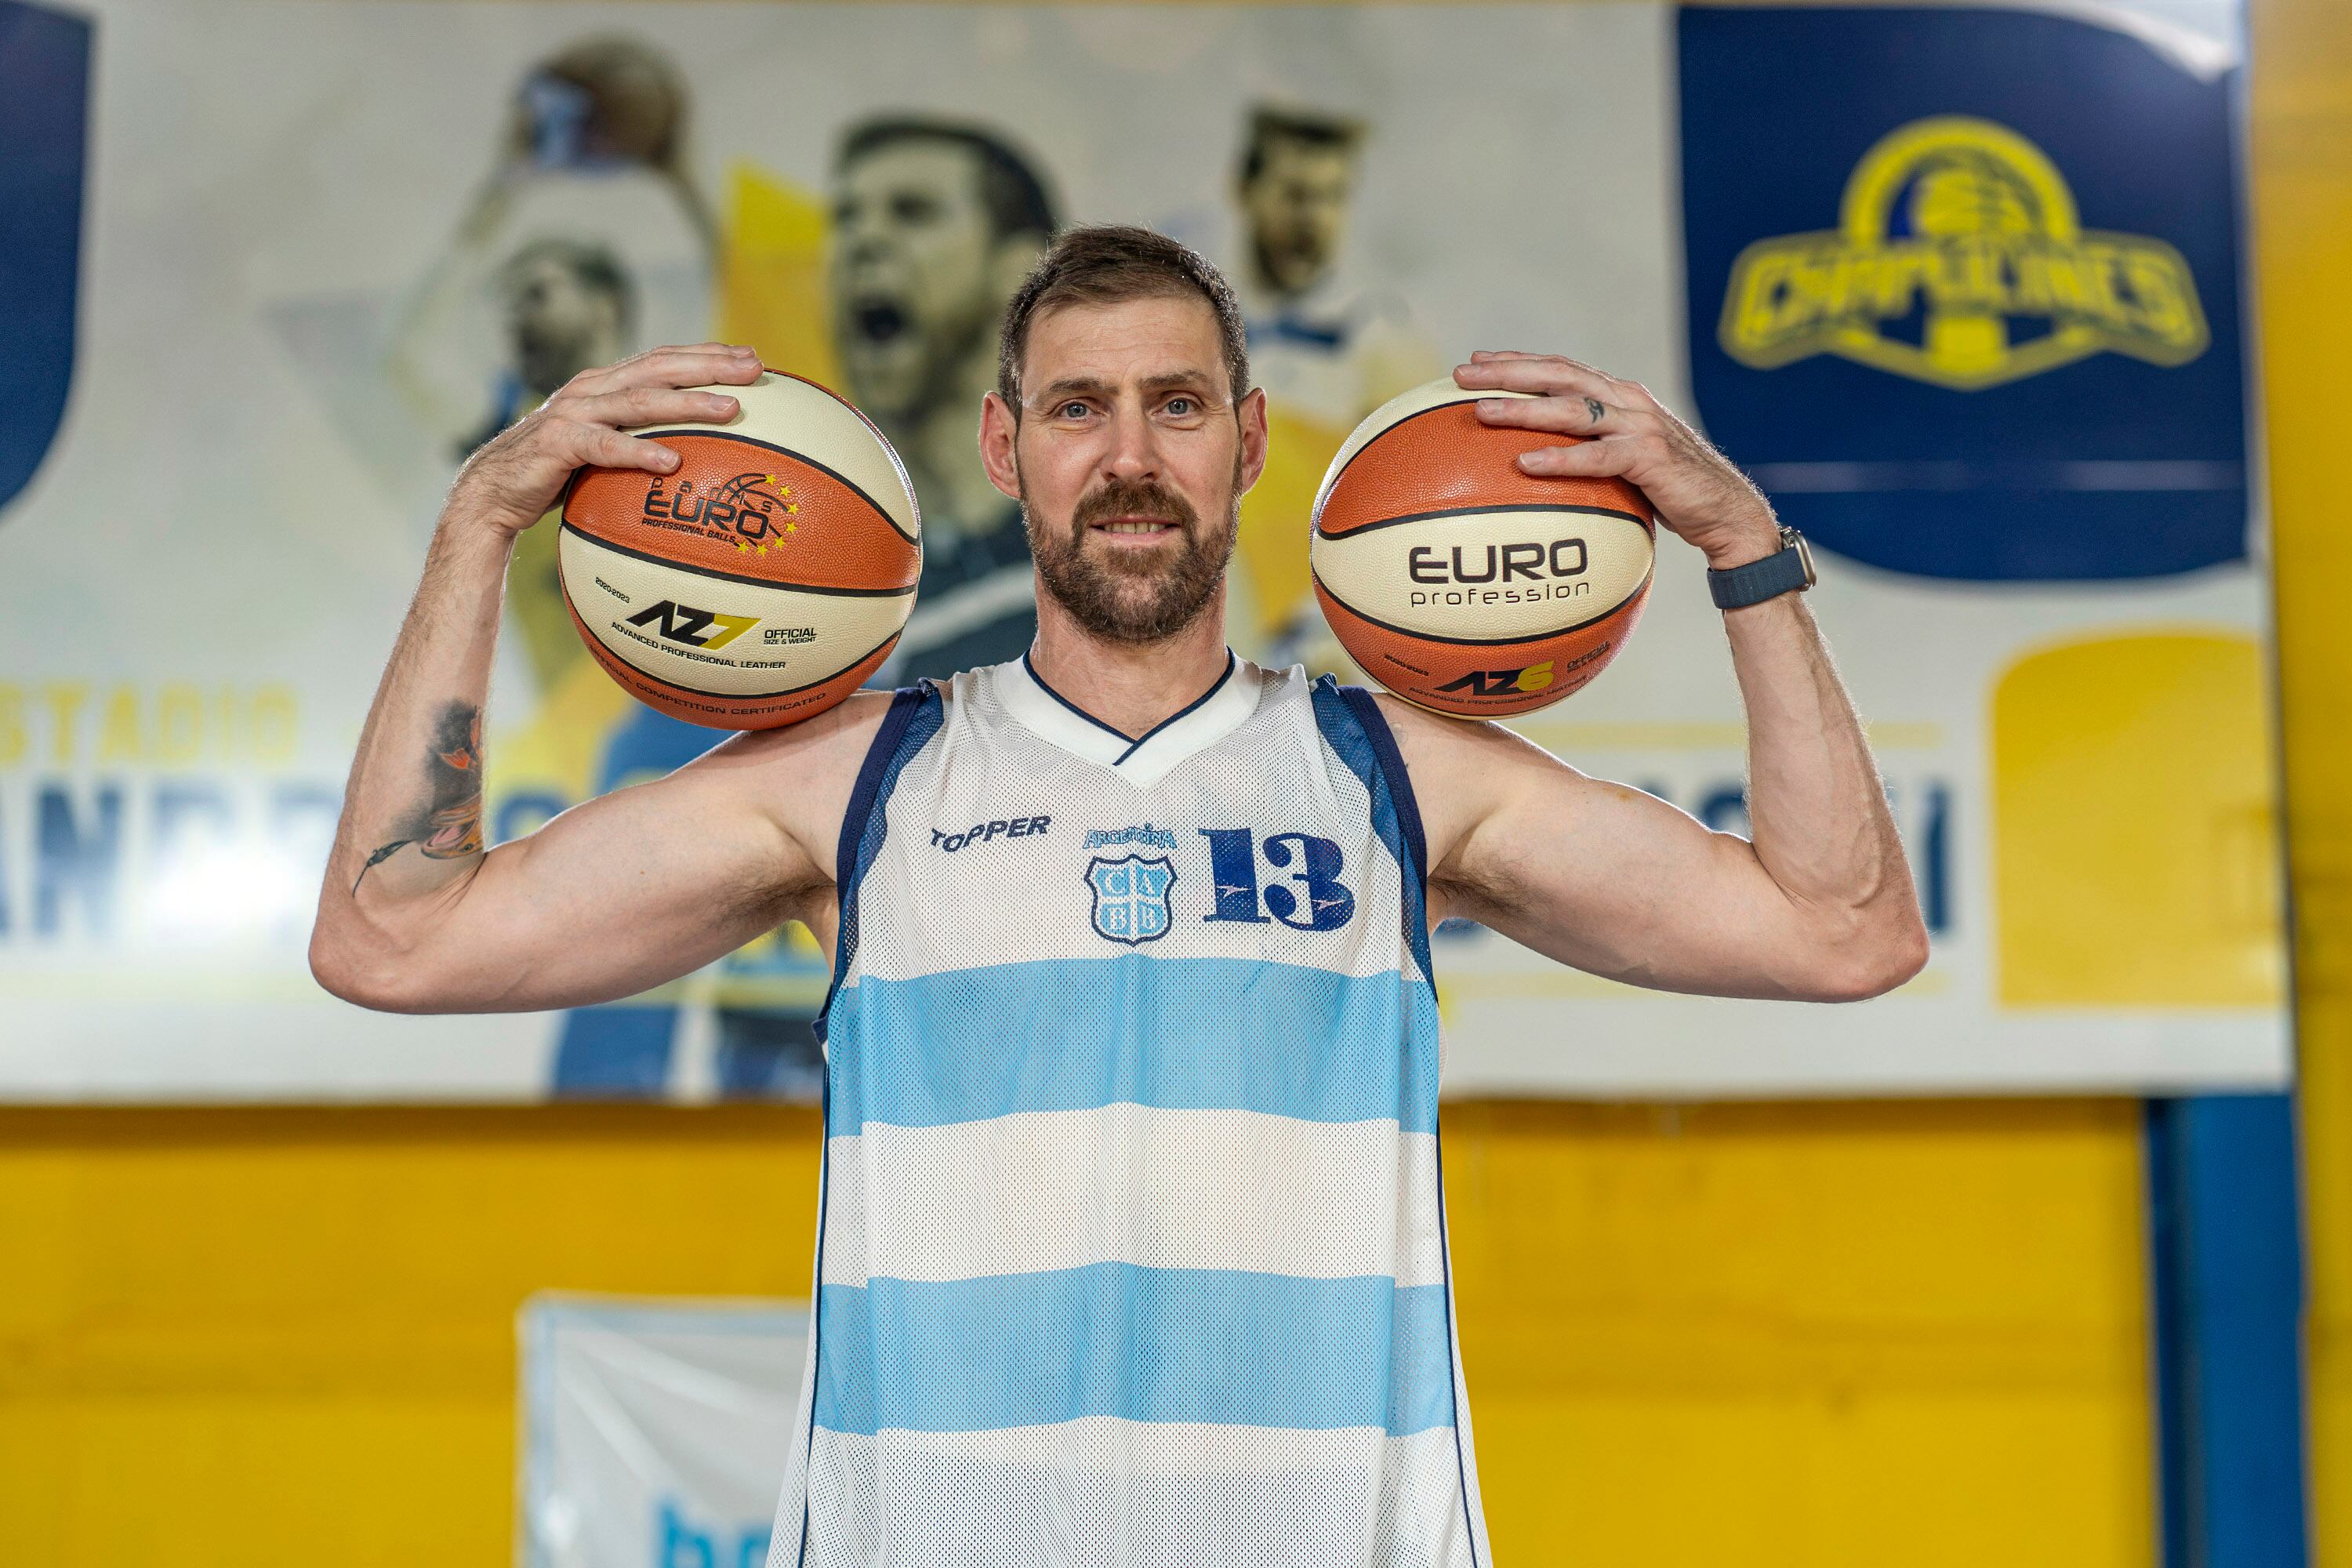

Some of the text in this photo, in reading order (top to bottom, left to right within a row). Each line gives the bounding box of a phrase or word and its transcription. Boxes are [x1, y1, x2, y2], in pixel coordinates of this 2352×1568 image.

[641, 518, 736, 543] PROFESSIONAL BALLS
[644, 489, 769, 539] EURO
[1409, 538, 1588, 585] EURO
[596, 576, 630, 604] 2020-2023
[1410, 582, 1590, 608] profession
[626, 600, 762, 651] AZ7
[764, 627, 818, 640] OFFICIAL
[789, 637, 817, 645] WEIGHT
[612, 622, 786, 670] ADVANCED PROFESSIONAL LEATHER
[1433, 659, 1555, 695] AZ6
[636, 681, 727, 715] COMPETITION
[731, 692, 826, 715] CERTIFICATED
[1409, 687, 1465, 703] ADVANCED
[1467, 692, 1544, 705] PROFESSIONAL
[930, 815, 1052, 853] TOPPER
[1082, 824, 1178, 849] ARGENTINA
[1198, 828, 1356, 931] 13
